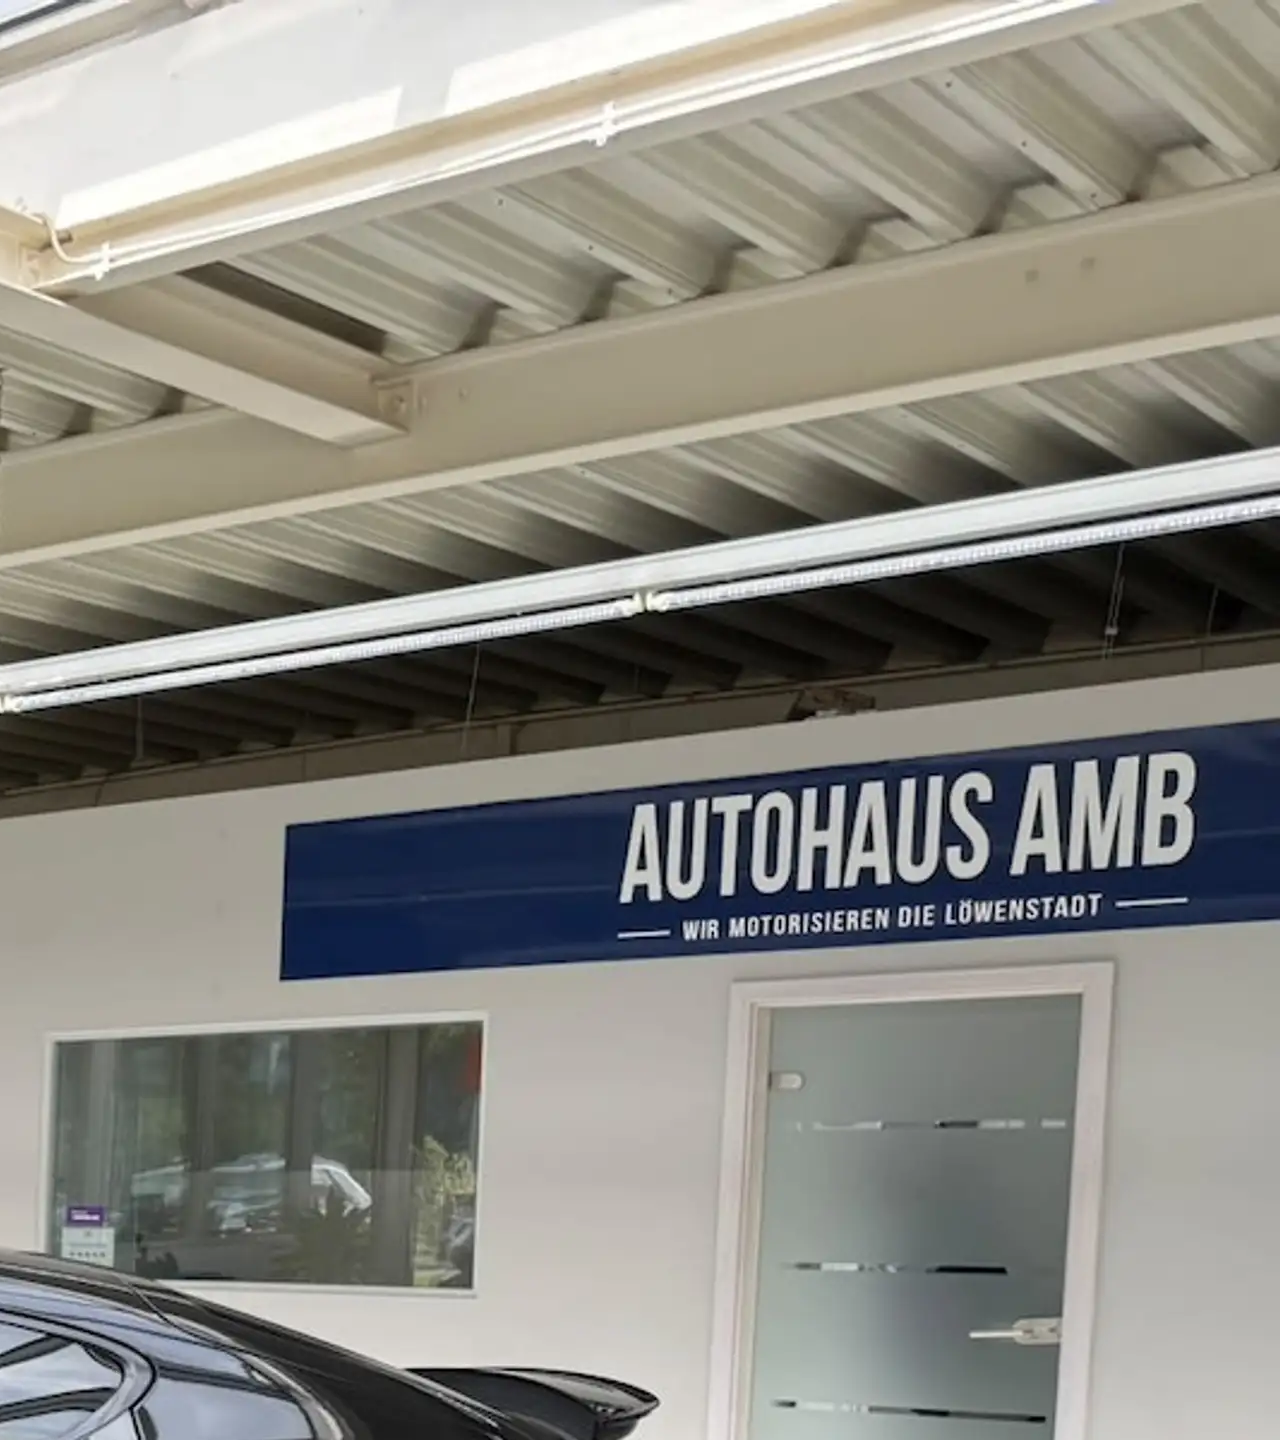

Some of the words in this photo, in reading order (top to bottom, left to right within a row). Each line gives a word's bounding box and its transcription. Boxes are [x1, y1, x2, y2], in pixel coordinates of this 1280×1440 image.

[619, 770, 994, 903] AUTOHAUS
[1008, 751, 1197, 876] AMB
[682, 918, 720, 941] WIR
[728, 908, 891, 938] MOTORISIEREN
[897, 904, 936, 929] DIE
[944, 892, 1103, 926] LÖWENSTADT
